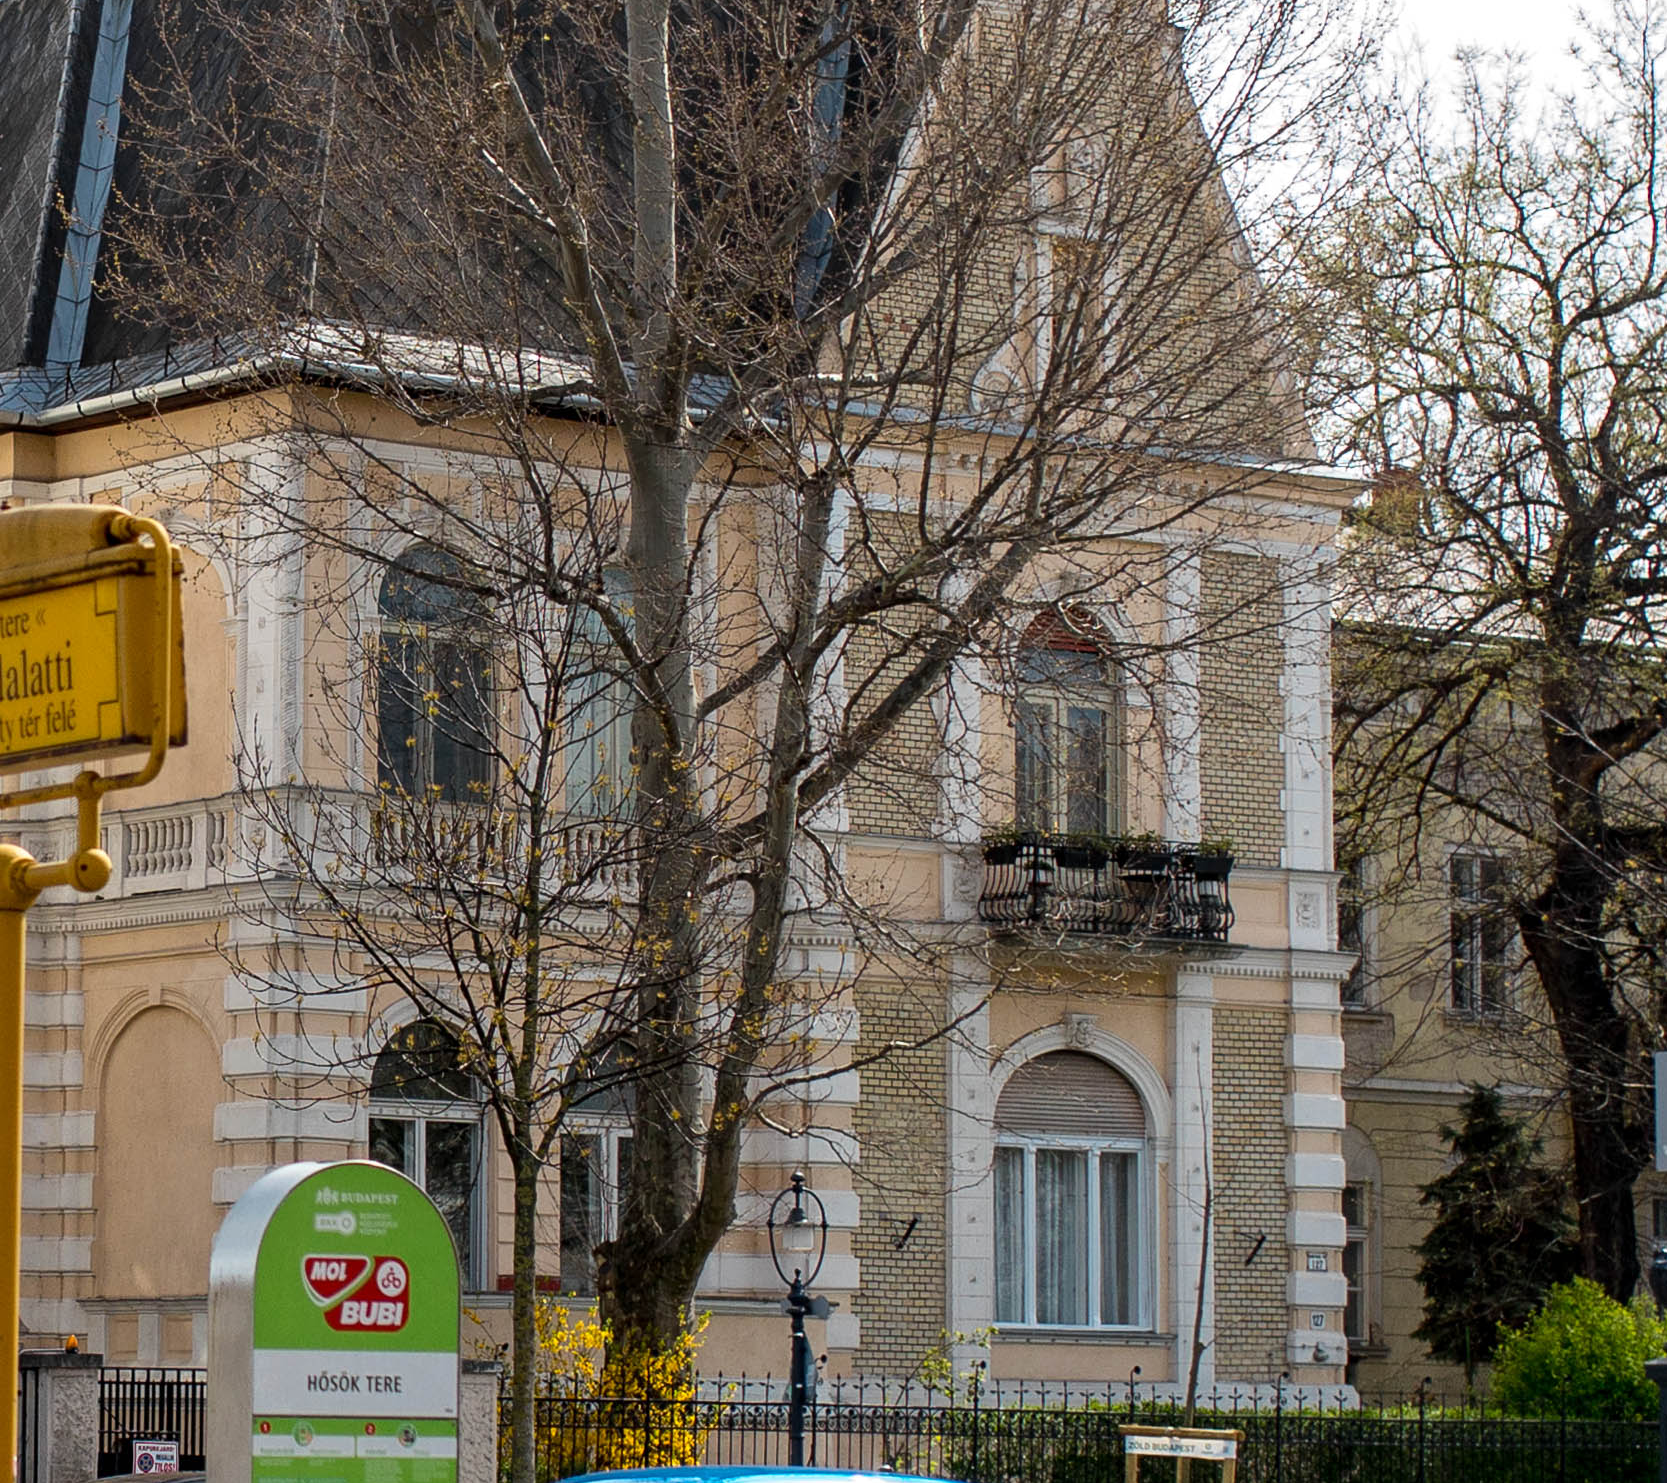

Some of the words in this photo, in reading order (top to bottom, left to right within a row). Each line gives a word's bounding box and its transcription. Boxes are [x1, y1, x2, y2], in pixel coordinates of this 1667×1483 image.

[0, 612, 30, 639] tere
[19, 708, 41, 739] tér
[45, 699, 76, 735] felé
[340, 1193, 399, 1206] BUDAPEST
[310, 1261, 348, 1282] MOL
[339, 1300, 404, 1327] BUBI
[307, 1372, 360, 1393] HŐSÖK
[366, 1375, 403, 1394] TERE
